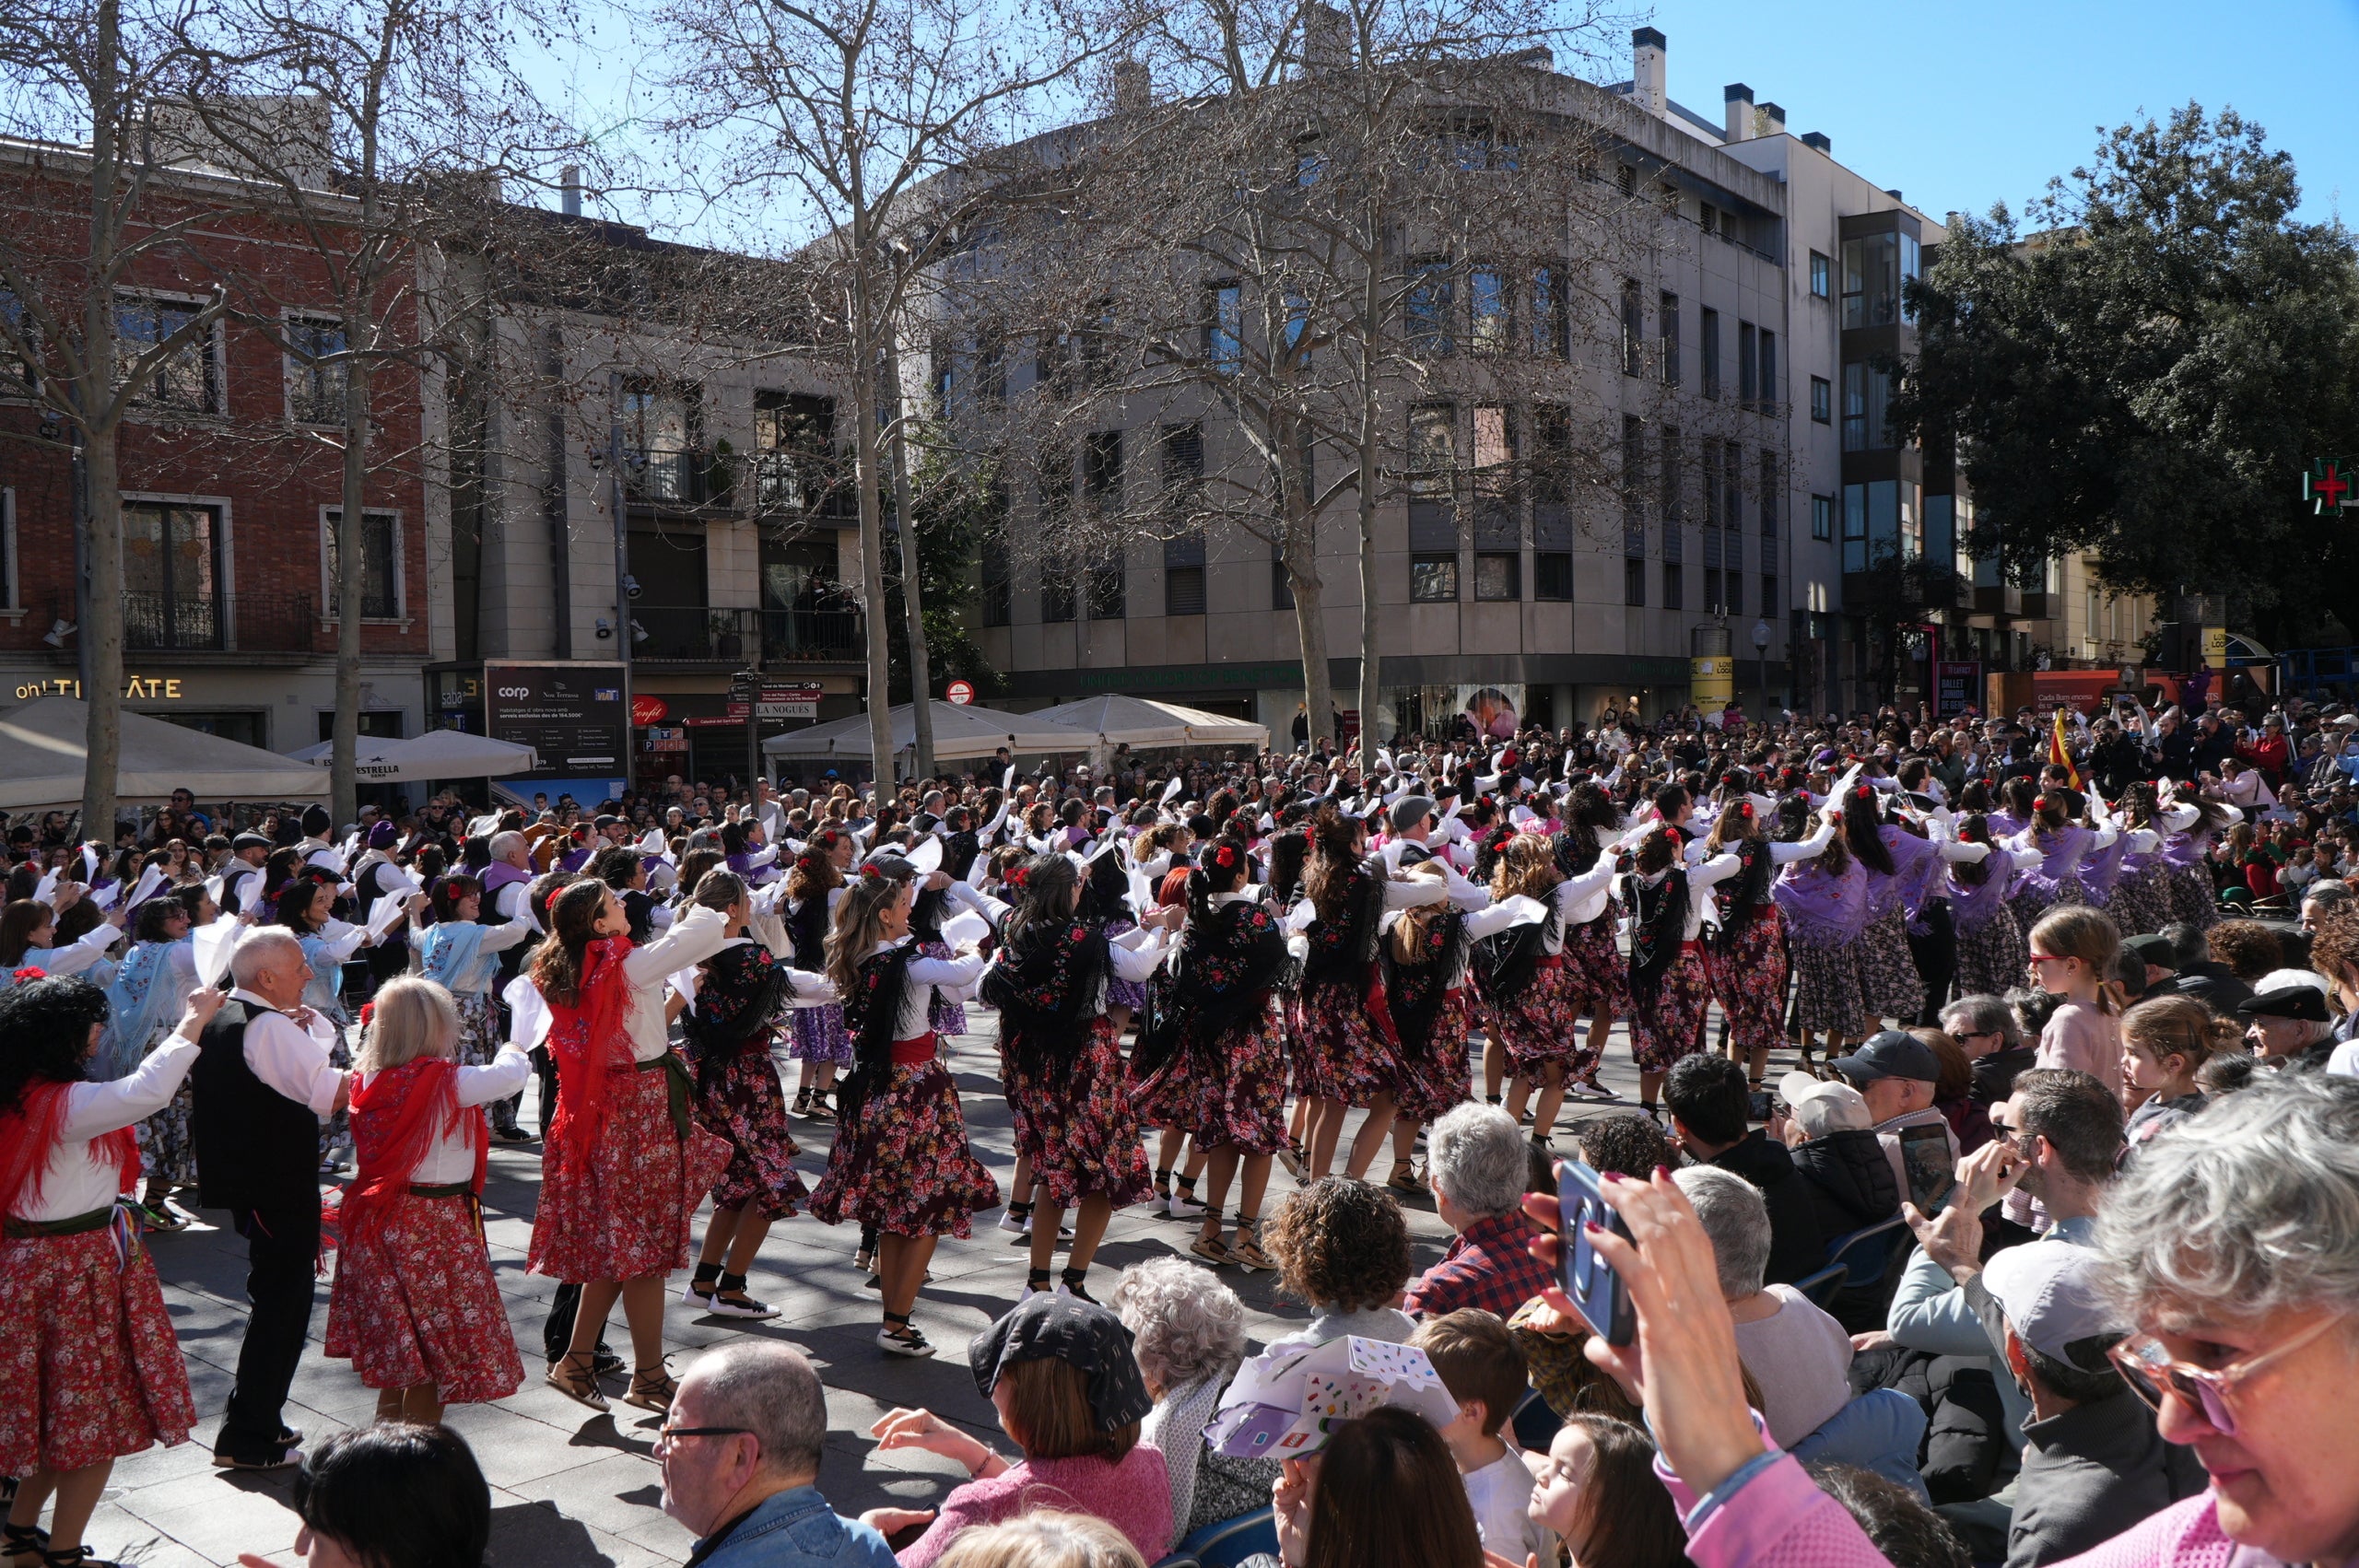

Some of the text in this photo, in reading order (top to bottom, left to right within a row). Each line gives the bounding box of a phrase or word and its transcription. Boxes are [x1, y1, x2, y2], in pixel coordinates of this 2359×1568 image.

[1941, 678, 1964, 689] BALLET
[499, 686, 530, 701] corp
[556, 691, 580, 699] Terrassa
[757, 705, 769, 714] LA
[646, 741, 652, 750] P
[356, 766, 399, 775] ESTRELLA
